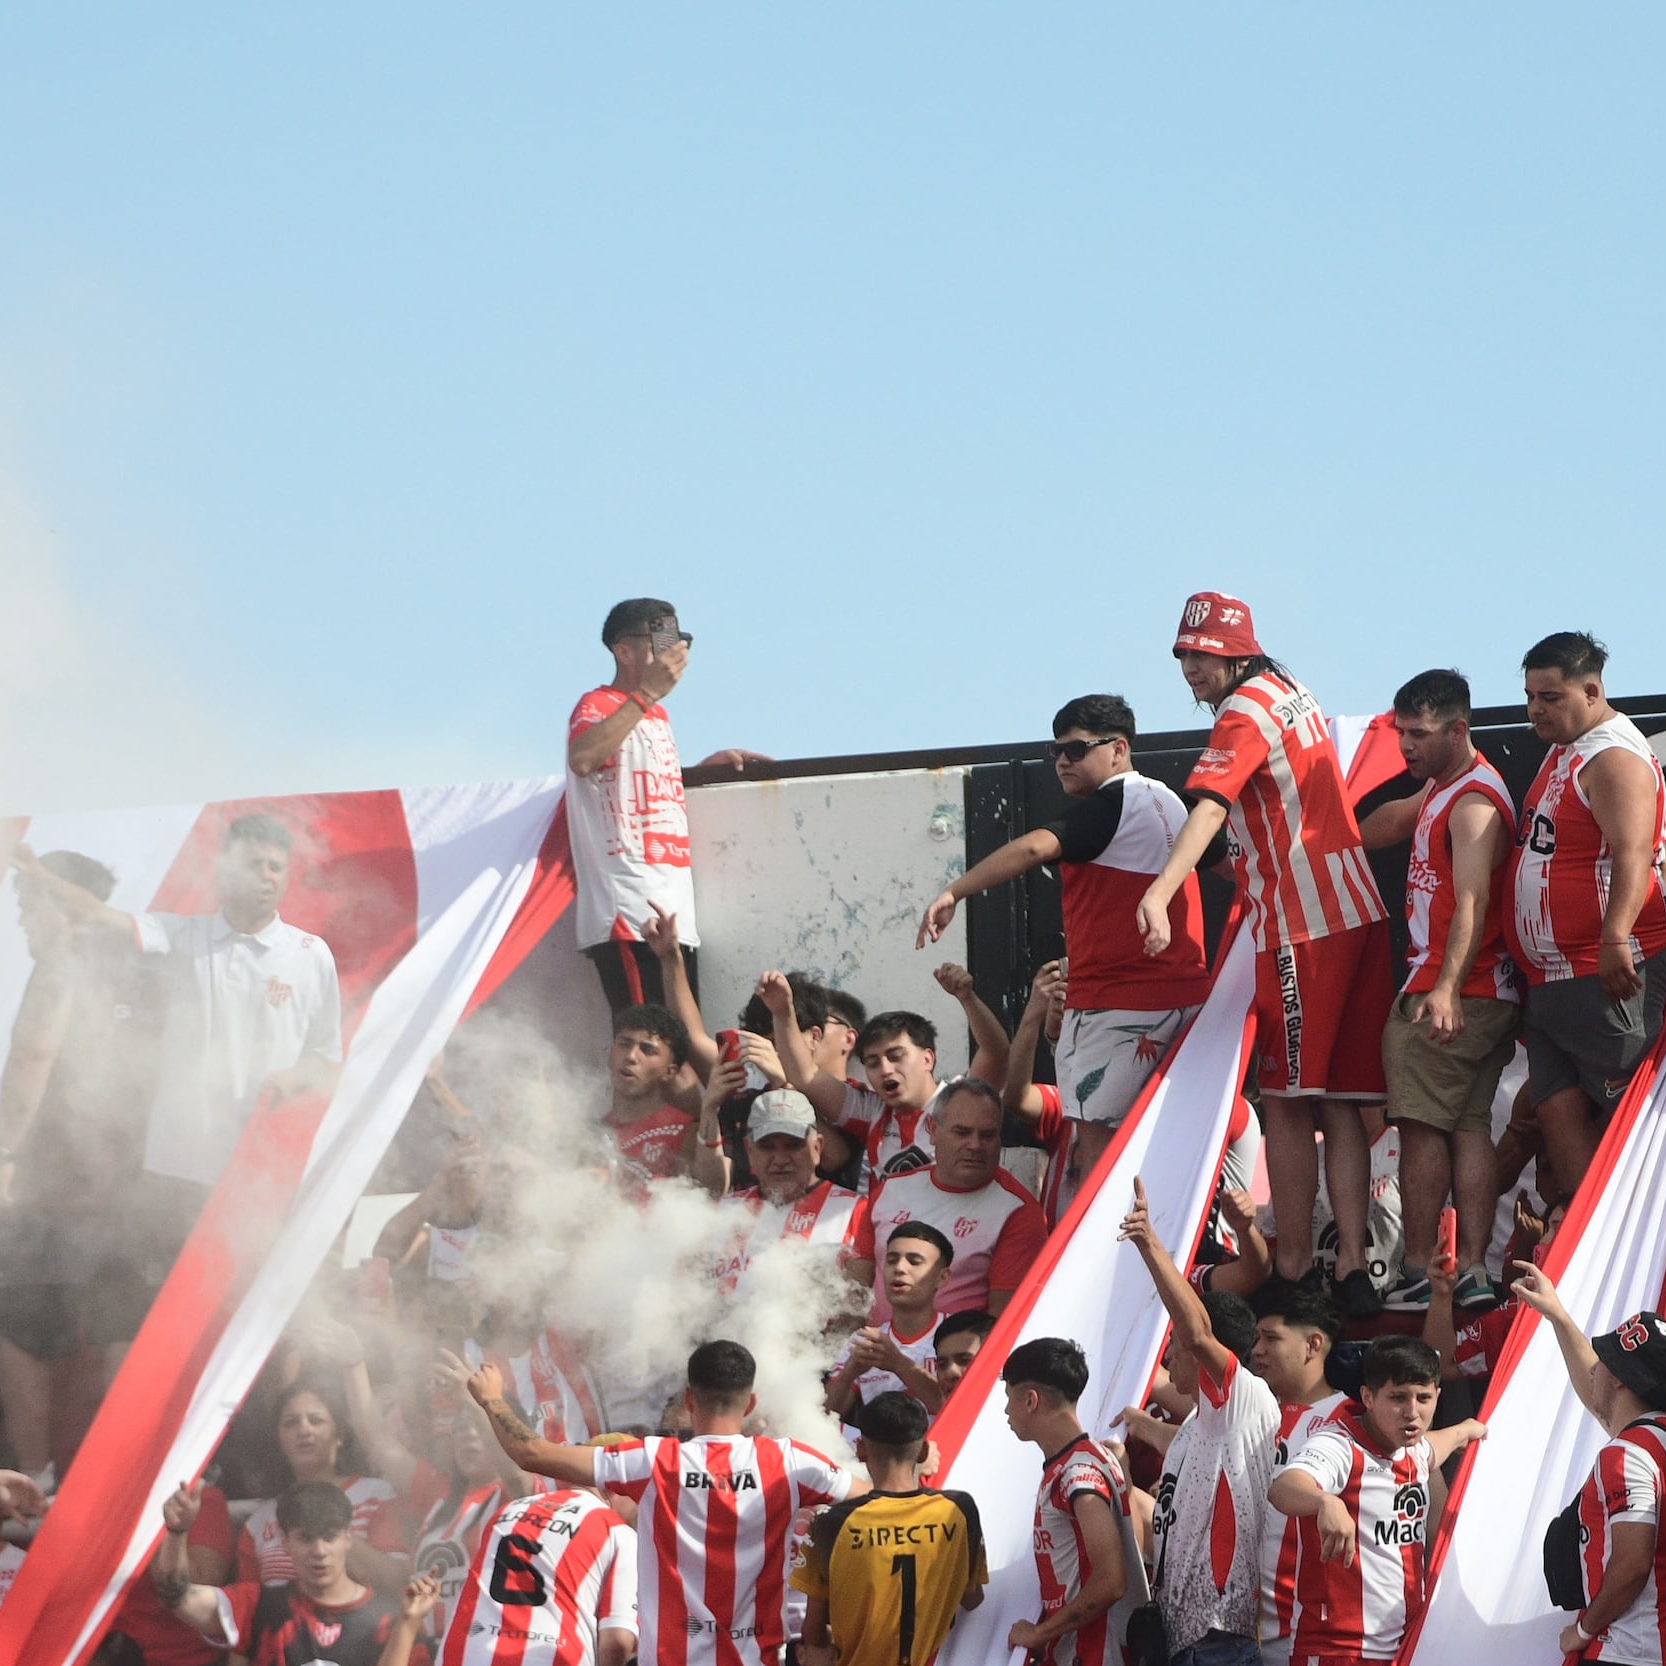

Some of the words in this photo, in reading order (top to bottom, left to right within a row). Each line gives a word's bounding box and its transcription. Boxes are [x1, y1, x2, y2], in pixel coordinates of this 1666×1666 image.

[1282, 955, 1300, 1014] BUSTOS
[684, 1470, 758, 1494] BRAVA
[849, 1522, 958, 1551] DIRECTV
[1373, 1519, 1424, 1546] Mac
[488, 1534, 548, 1607] 6
